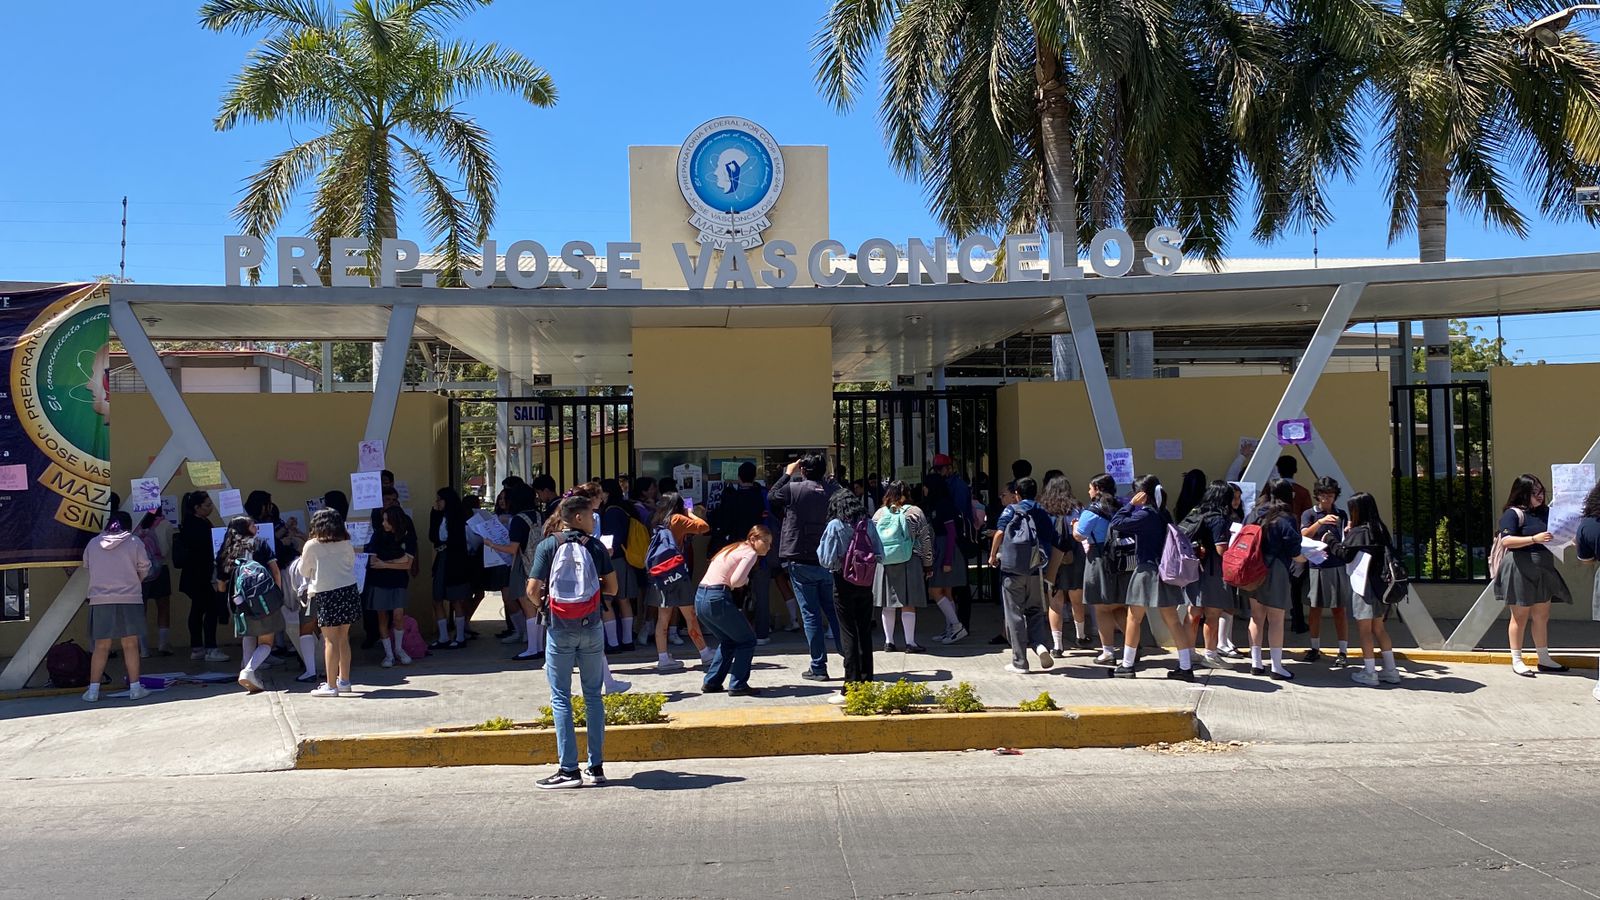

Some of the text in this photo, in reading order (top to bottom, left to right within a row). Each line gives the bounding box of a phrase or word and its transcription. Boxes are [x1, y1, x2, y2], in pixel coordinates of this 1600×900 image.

[681, 131, 704, 191] PREPARATORIA
[704, 119, 740, 133] FEDERAL
[742, 121, 760, 135] POR
[224, 226, 1182, 290] PREP. JOSE VASCONCELOS
[50, 471, 110, 506] MAZ
[663, 572, 683, 585] FILA
